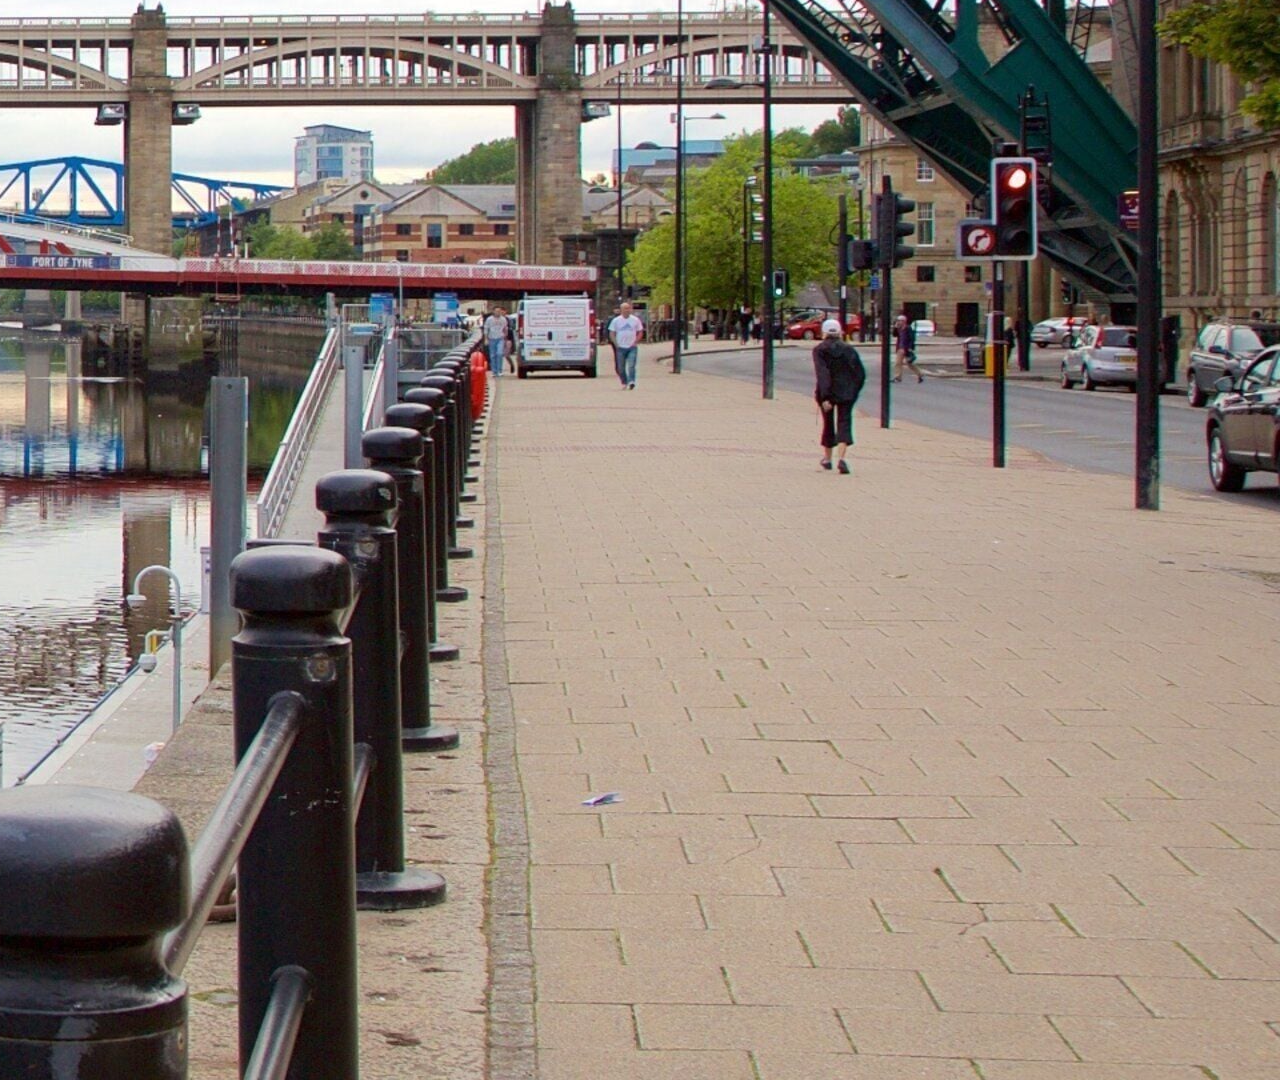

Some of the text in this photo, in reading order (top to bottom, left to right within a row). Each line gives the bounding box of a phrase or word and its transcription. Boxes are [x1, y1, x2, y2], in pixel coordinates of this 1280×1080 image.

[32, 256, 94, 268] PORT OF TYNE
